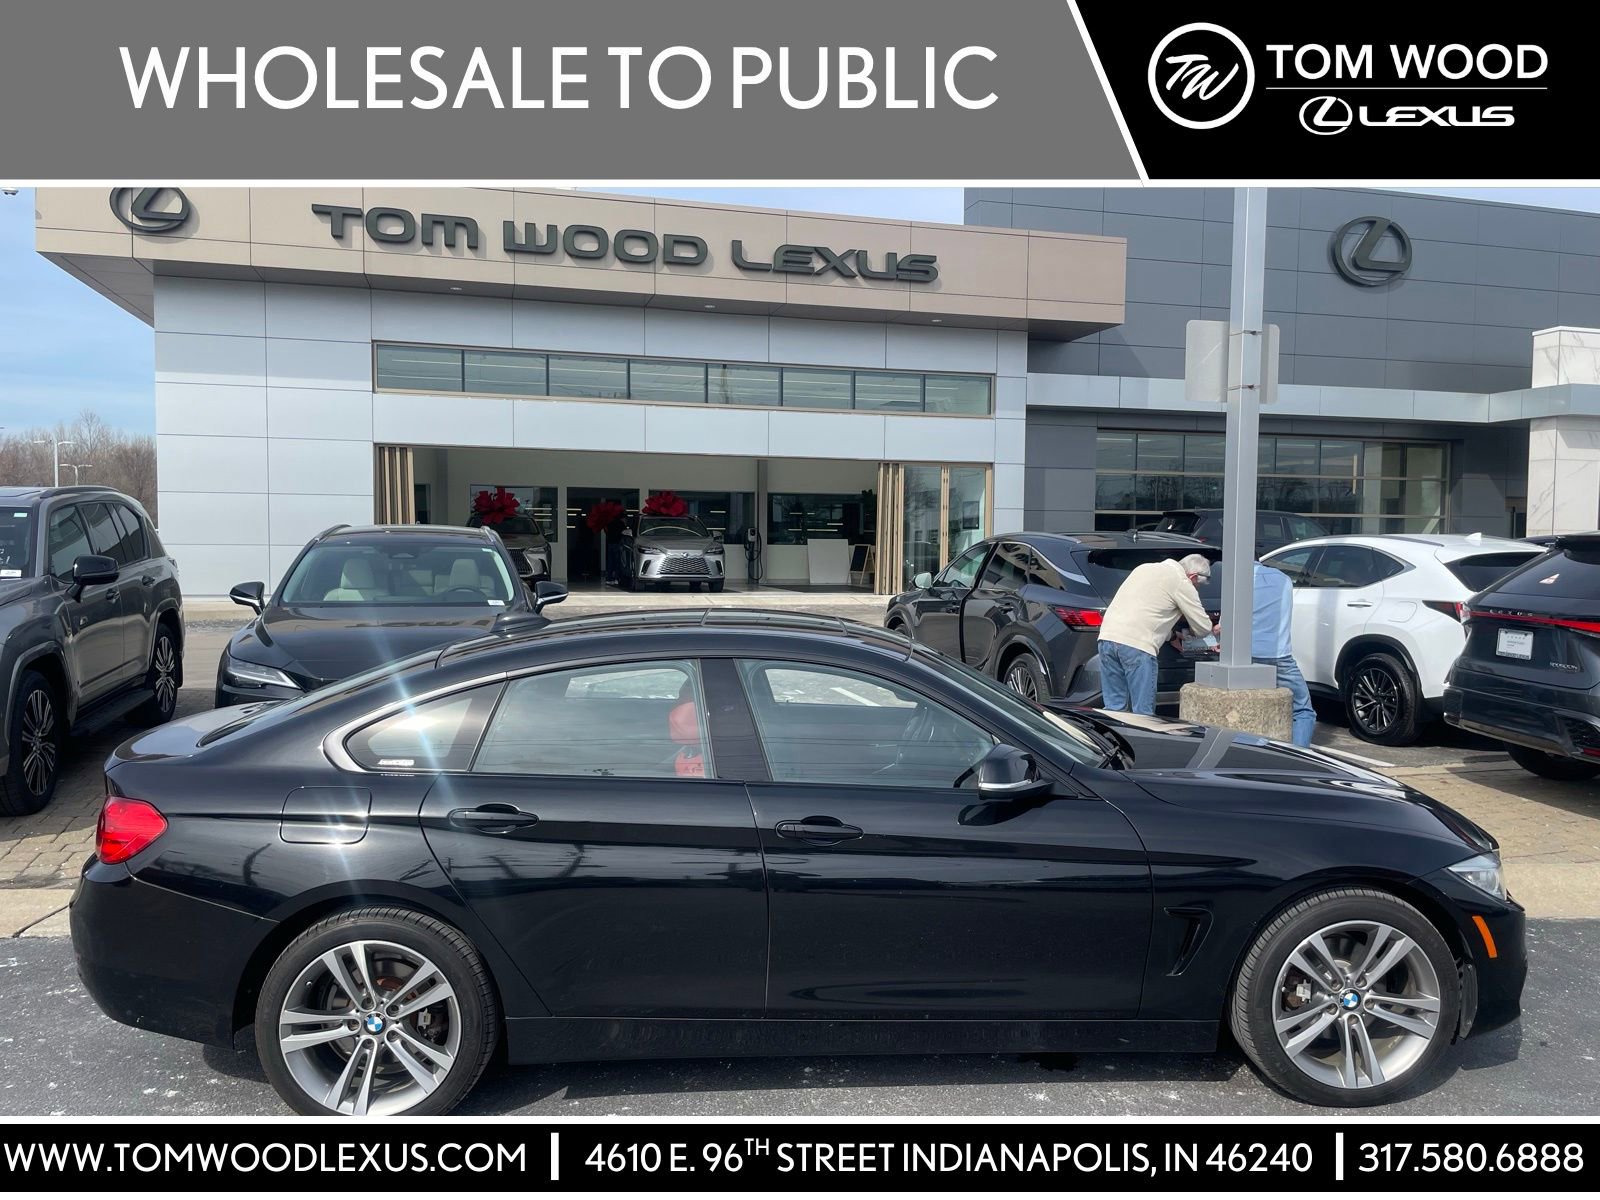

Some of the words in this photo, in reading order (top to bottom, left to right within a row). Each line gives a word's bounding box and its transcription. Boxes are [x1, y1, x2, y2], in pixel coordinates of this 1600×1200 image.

[312, 203, 479, 249] TOM
[503, 220, 708, 265] WOOD
[731, 239, 939, 282] LEXUS
